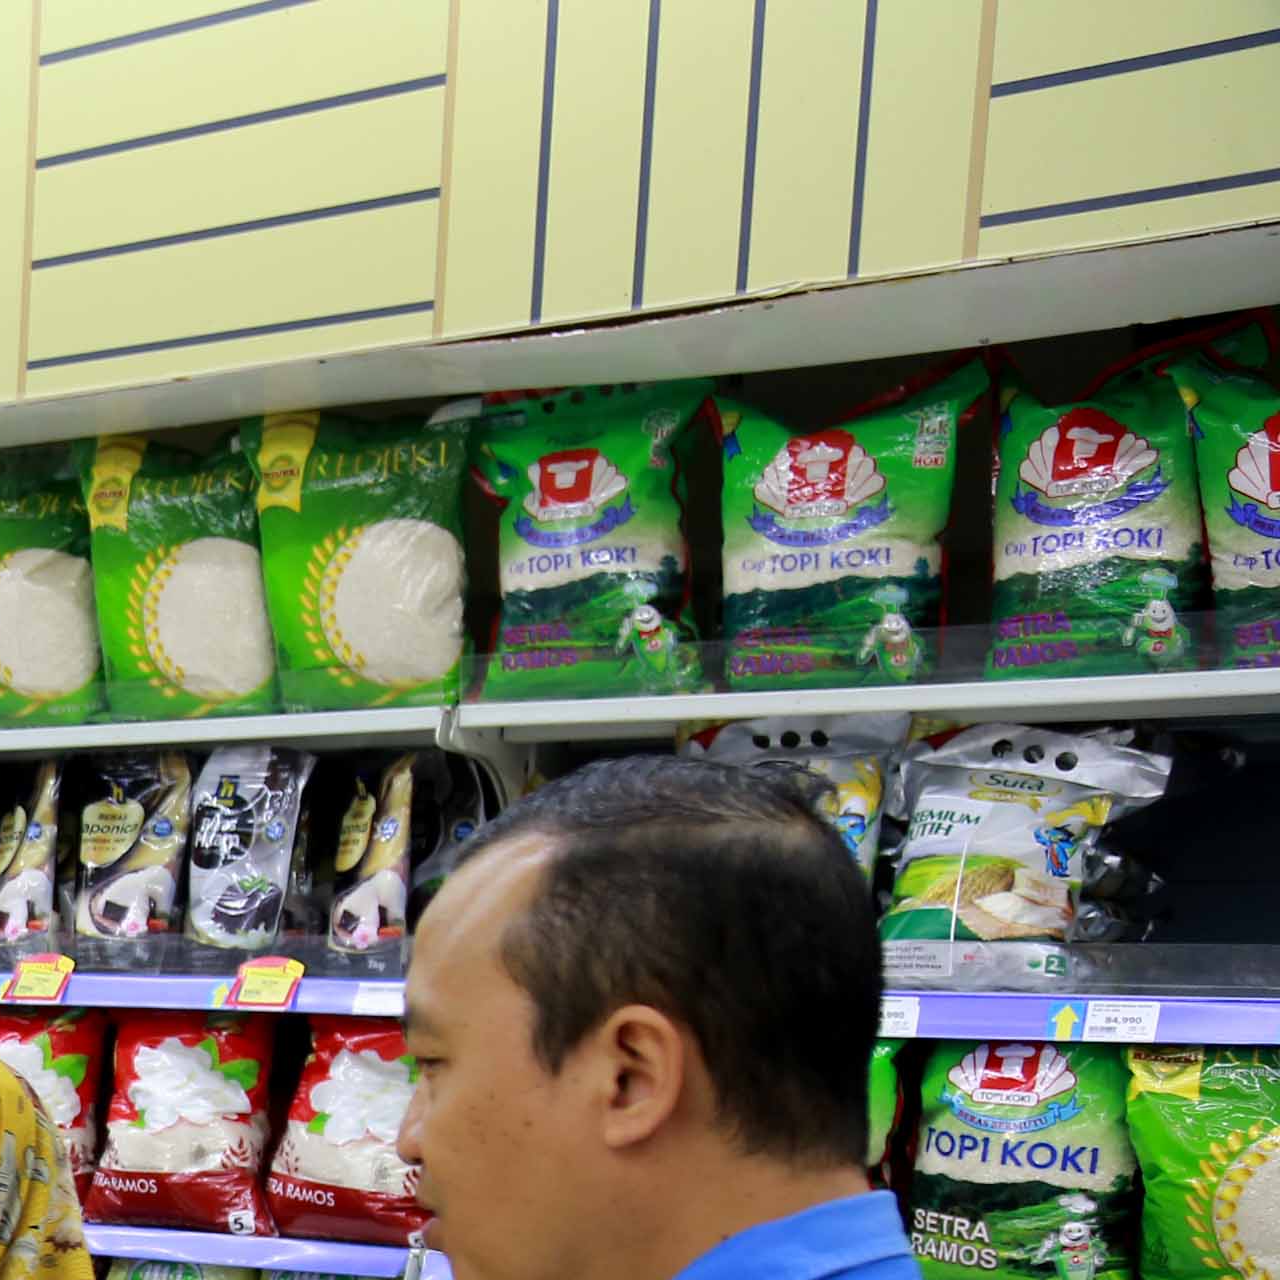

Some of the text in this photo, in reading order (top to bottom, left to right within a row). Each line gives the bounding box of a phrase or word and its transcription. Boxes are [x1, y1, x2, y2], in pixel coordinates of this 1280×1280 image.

[1031, 532, 1084, 557] TOPI
[1095, 527, 1164, 549] KOKI
[527, 553, 573, 575] TOPI
[769, 553, 819, 575] TOPI
[830, 547, 891, 568] KOKI
[911, 809, 981, 826] REMIUM
[909, 823, 953, 840] UTIH
[1006, 1094, 1031, 1103] KOKI
[926, 1127, 1099, 1175] TOPI KOKI
[111, 1176, 158, 1194] RAMOS
[286, 1183, 336, 1207] RAMOS
[913, 1208, 991, 1244] SETRA
[911, 1231, 999, 1271] RAMOS
